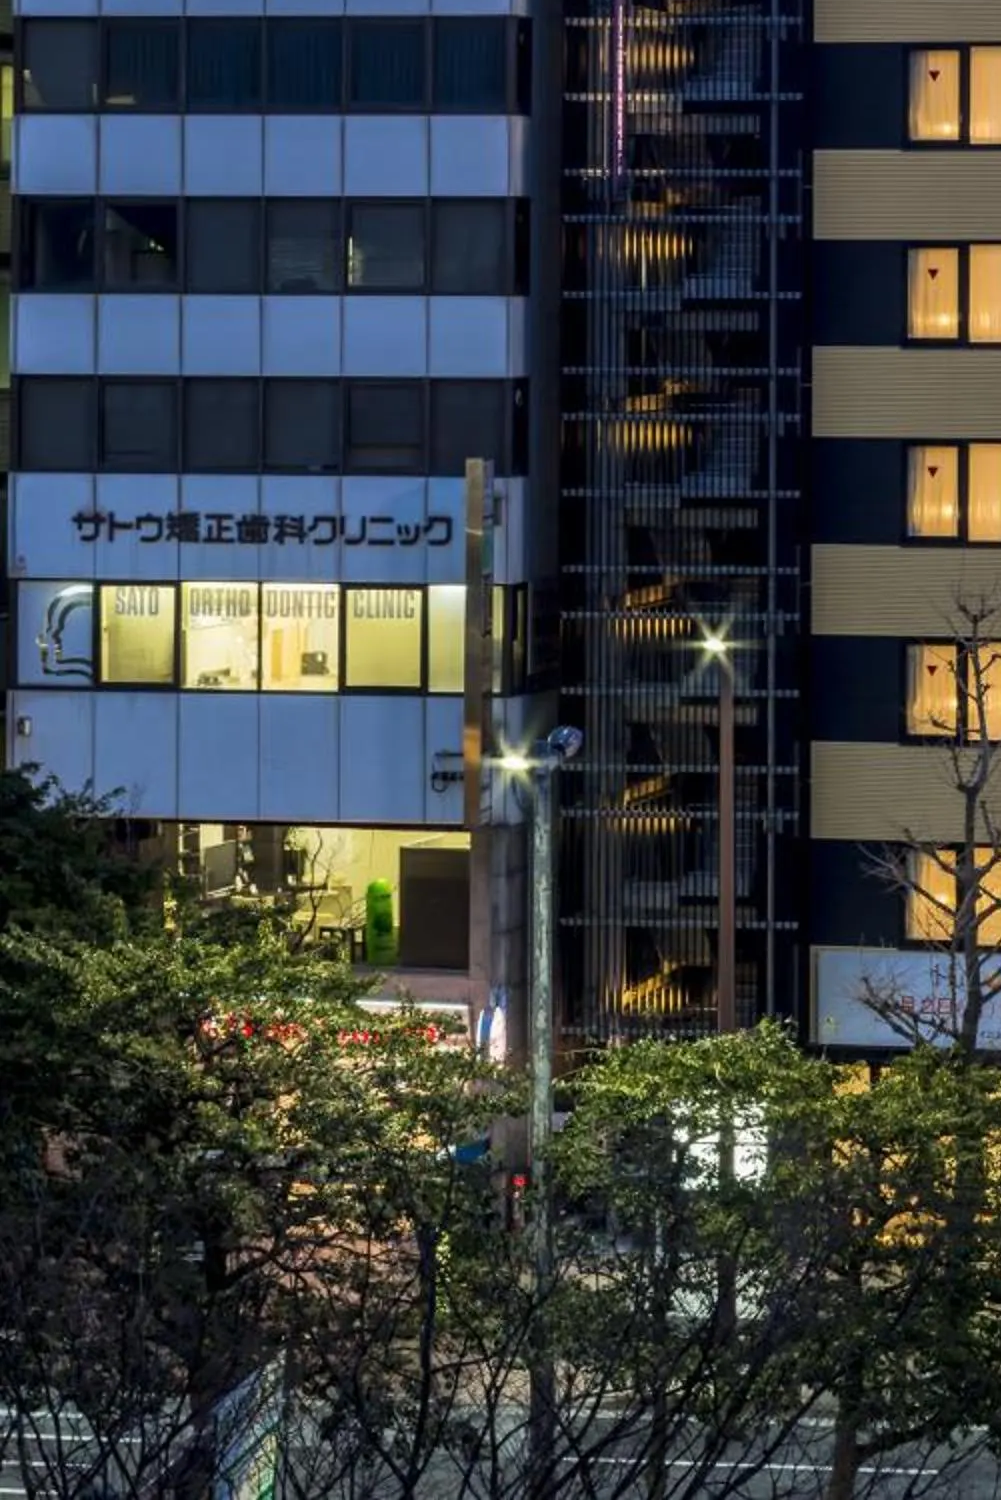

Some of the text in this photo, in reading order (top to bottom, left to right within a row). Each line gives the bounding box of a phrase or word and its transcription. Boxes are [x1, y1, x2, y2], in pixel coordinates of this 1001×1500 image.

[72, 511, 454, 546] サトウ矯正歯科クリニック
[114, 586, 416, 619] SATO ORTHO DONTIC CLINIC
